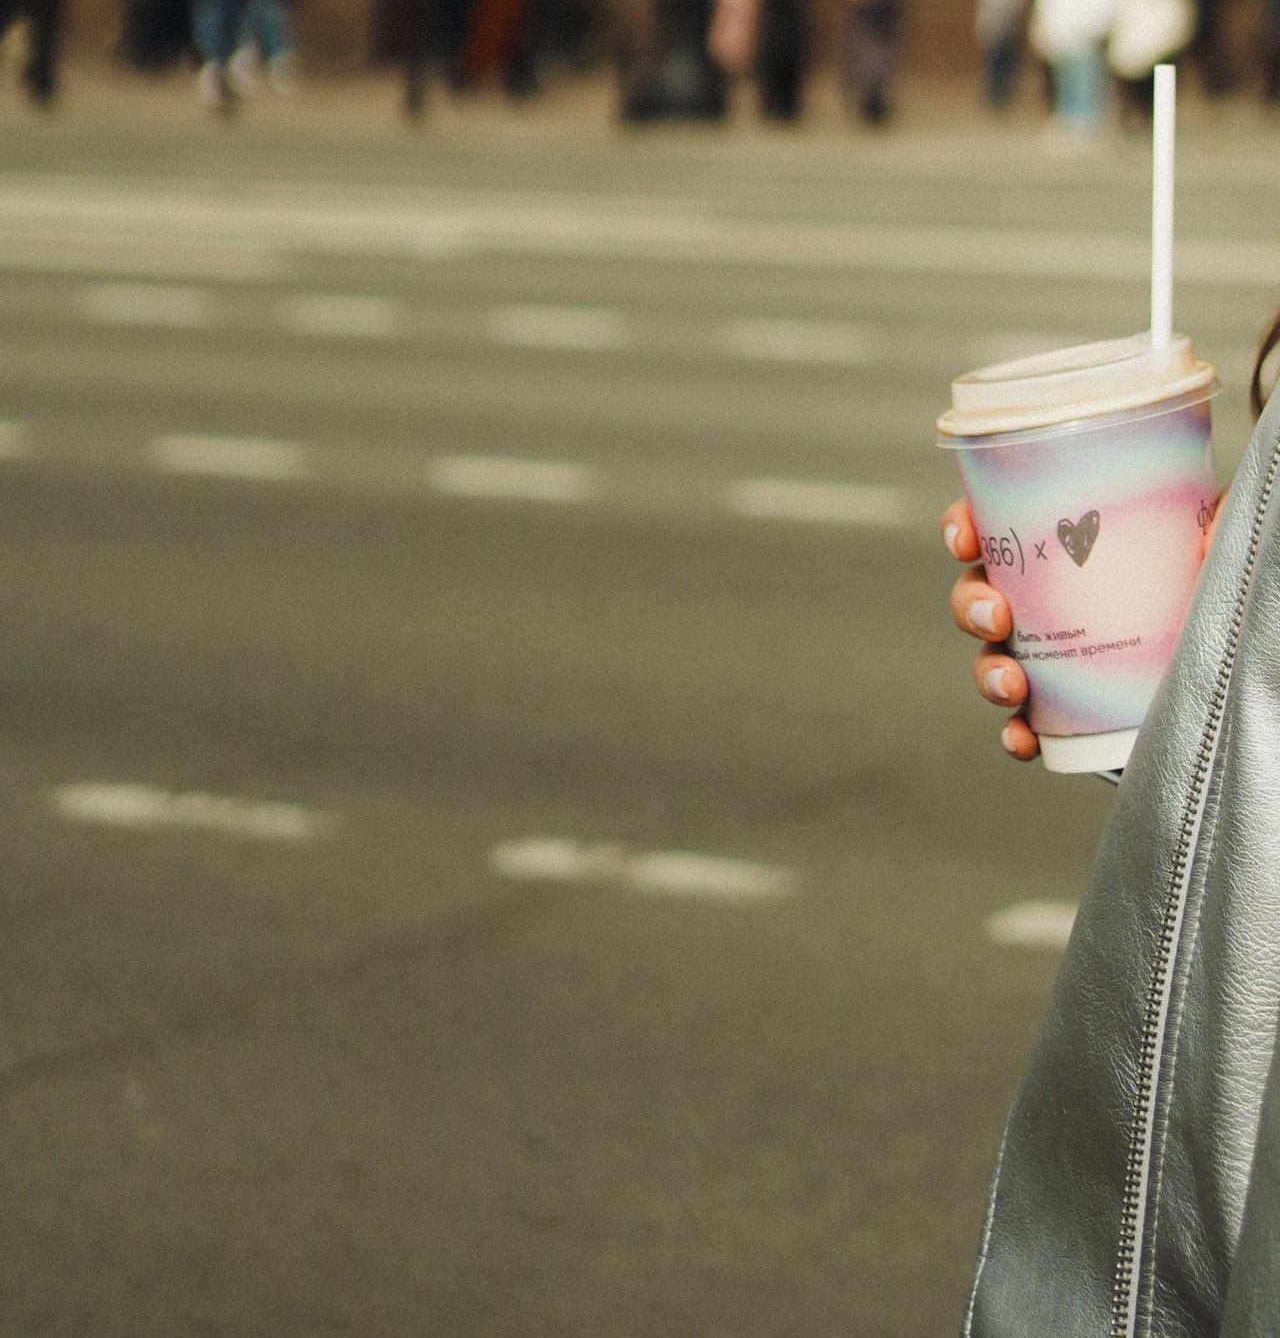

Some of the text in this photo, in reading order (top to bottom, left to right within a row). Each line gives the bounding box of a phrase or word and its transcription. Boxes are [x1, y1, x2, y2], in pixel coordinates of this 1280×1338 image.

[1017, 628, 1087, 642] быть живым
[1031, 648, 1077, 661] момент
[1081, 636, 1142, 658] времени
